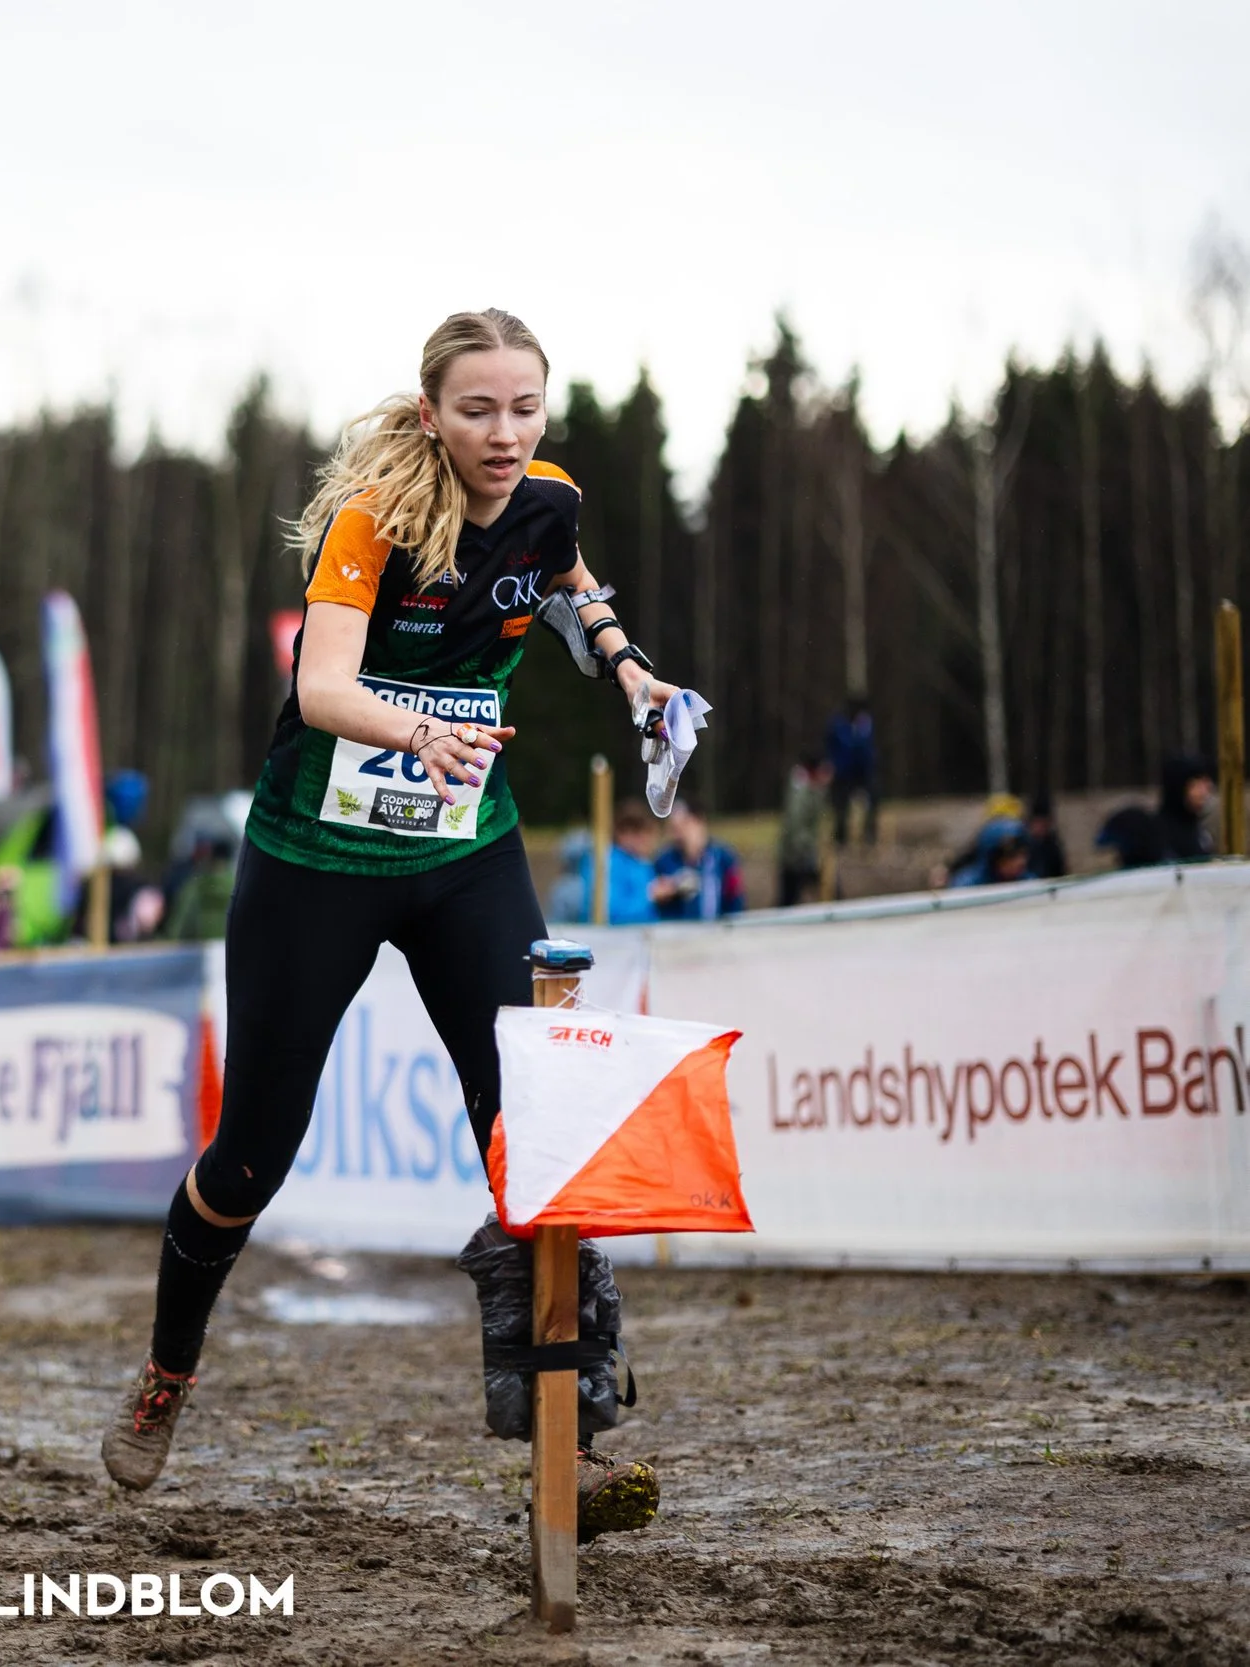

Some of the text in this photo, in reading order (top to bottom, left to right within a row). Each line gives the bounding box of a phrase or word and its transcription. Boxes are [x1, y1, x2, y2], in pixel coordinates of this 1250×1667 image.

[492, 569, 542, 610] OKK
[400, 600, 445, 611] SPORT
[392, 619, 445, 634] TRIMTEX
[380, 794, 437, 809] GODKÄNDA
[766, 1030, 1129, 1143] Landshypotek
